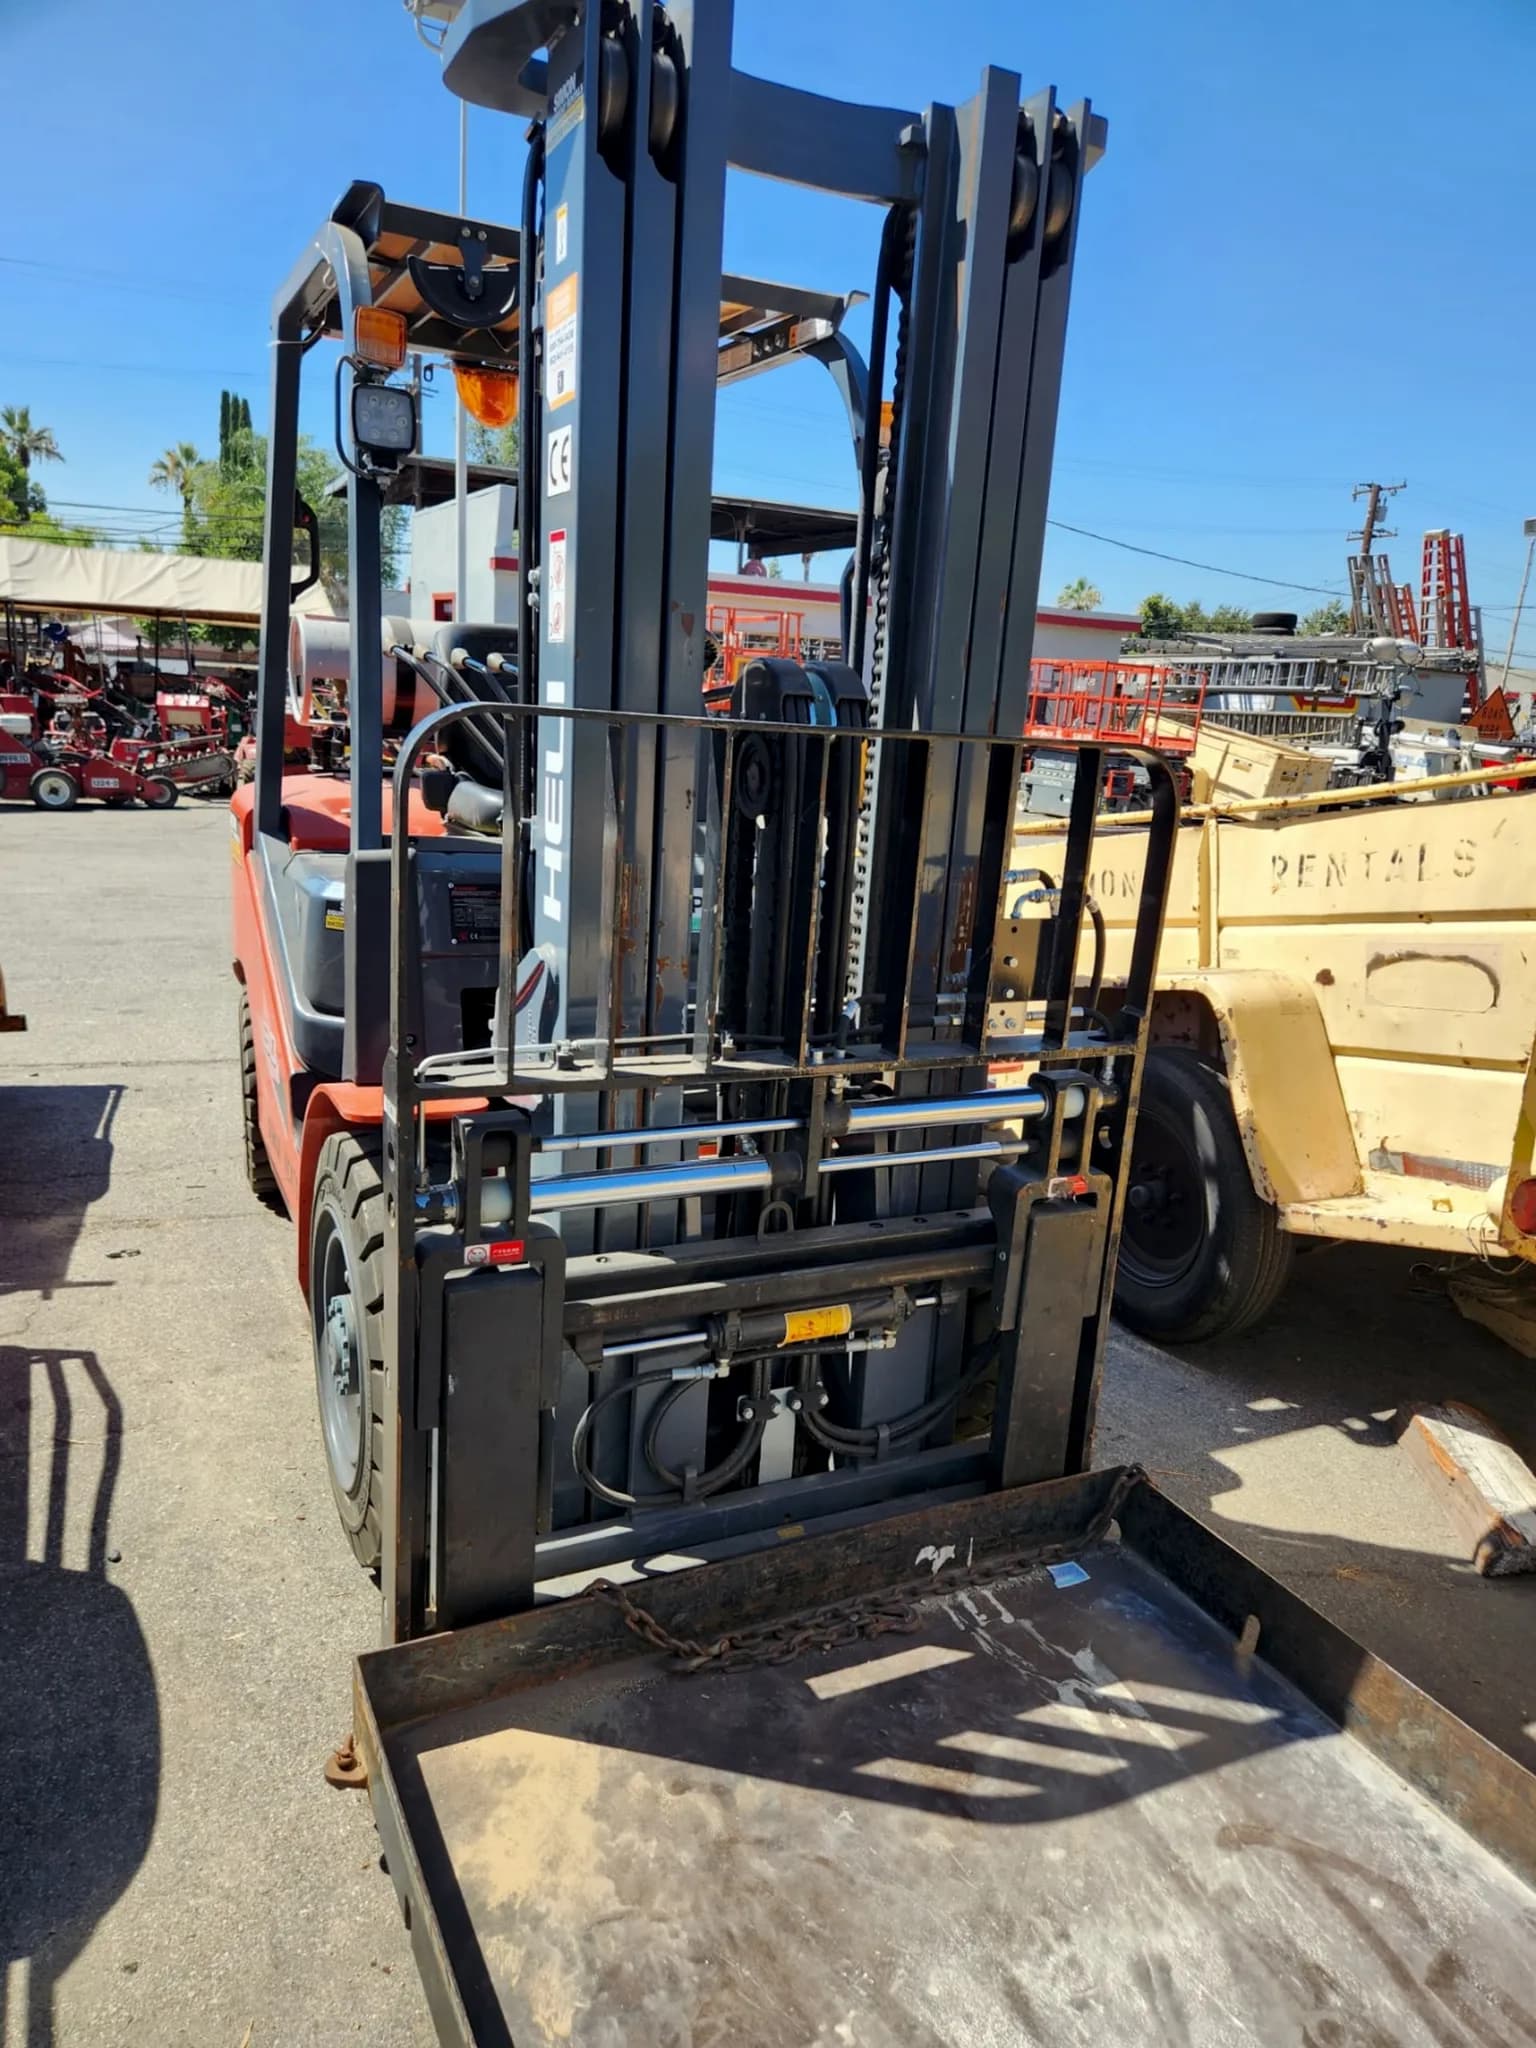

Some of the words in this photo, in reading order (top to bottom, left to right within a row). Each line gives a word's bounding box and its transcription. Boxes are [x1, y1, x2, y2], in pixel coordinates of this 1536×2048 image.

[549, 434, 570, 487] CE
[543, 680, 566, 923] HELI
[1271, 838, 1478, 890] RENTALS
